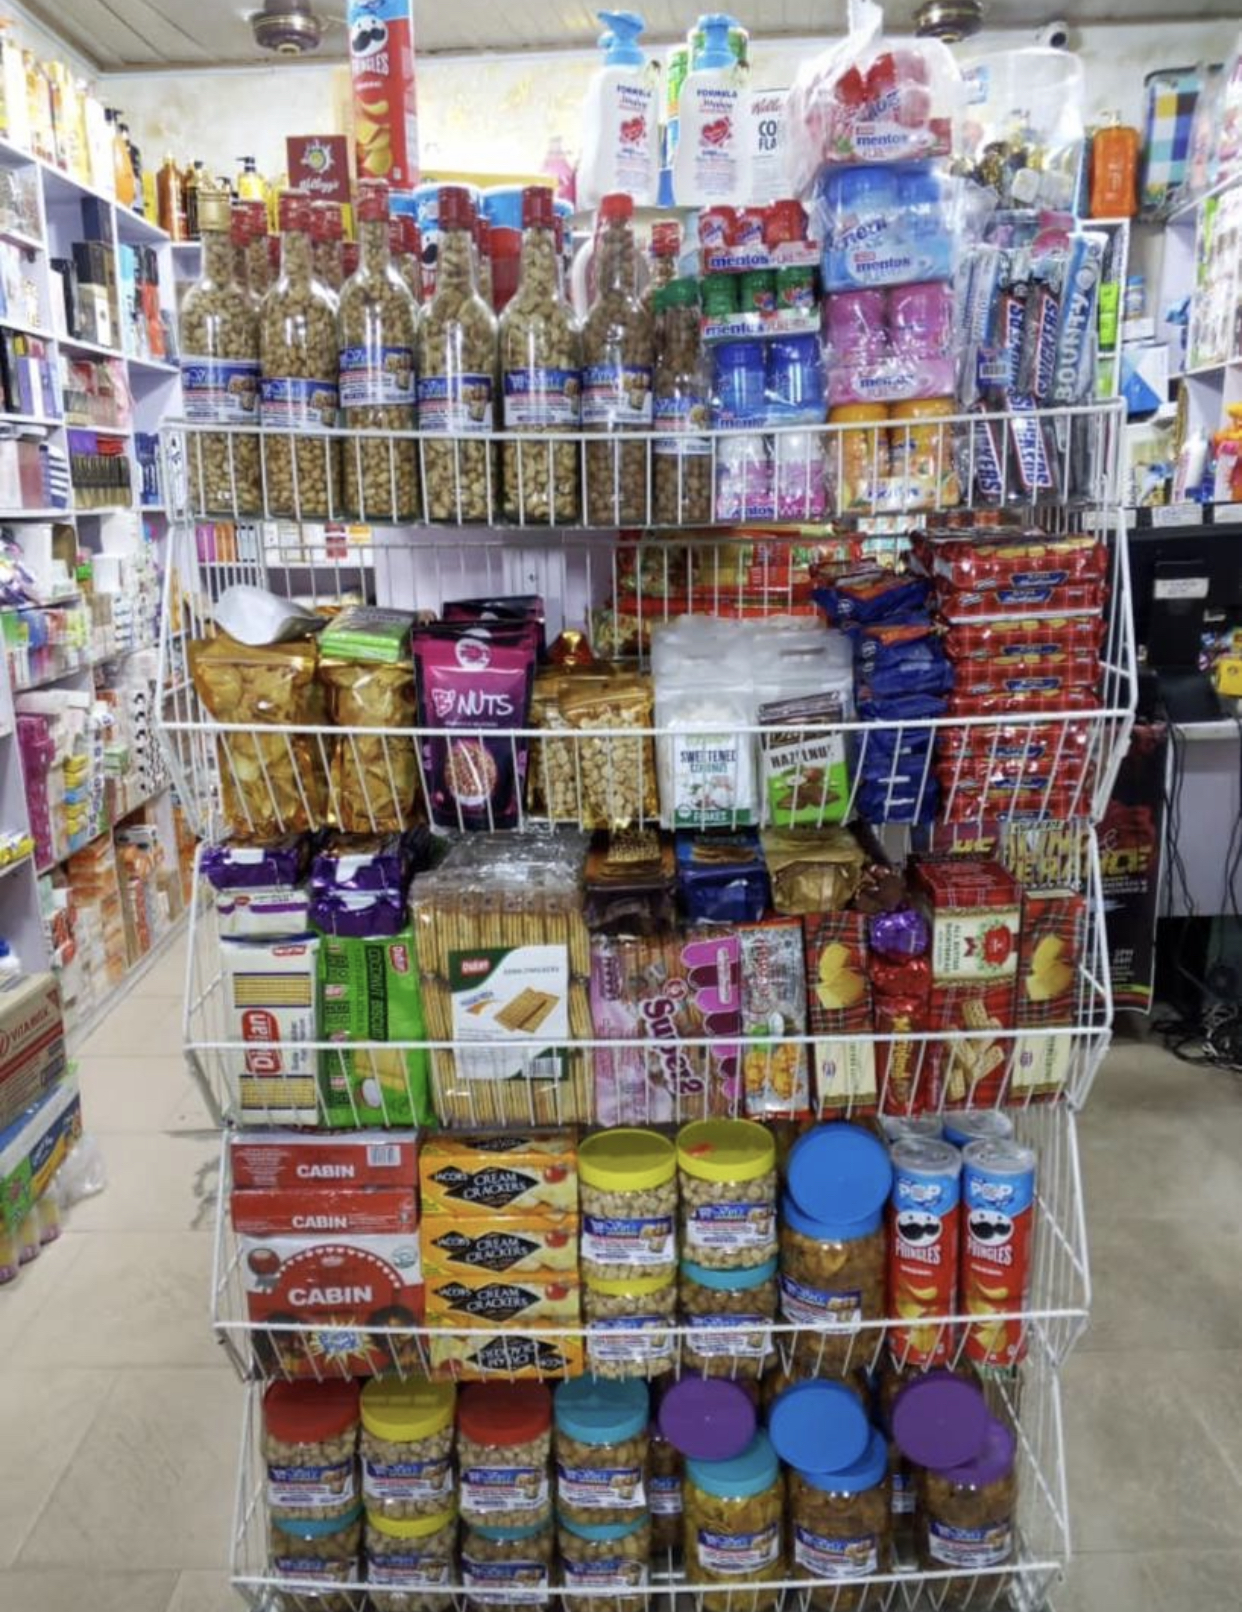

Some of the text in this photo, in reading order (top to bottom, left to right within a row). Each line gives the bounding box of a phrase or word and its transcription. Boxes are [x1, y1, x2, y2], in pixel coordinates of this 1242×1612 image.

[696, 88, 738, 98] FORMULA
[710, 254, 769, 268] mentos
[1036, 299, 1058, 398] SNICKERS
[1054, 292, 1089, 402] BOUNTY
[457, 688, 514, 716] NUTS
[770, 745, 833, 769] HAZLNU
[296, 1164, 355, 1178] CABIN
[474, 1173, 517, 1186] CREAM
[463, 1183, 526, 1199] CRACKERS
[292, 1215, 348, 1229] CABIN
[476, 1239, 519, 1251] CREAM
[465, 1247, 528, 1262] CRACKERS
[288, 1285, 373, 1306] CABIN
[477, 1289, 520, 1300] CREAM
[466, 1297, 529, 1312] CRACKERS
